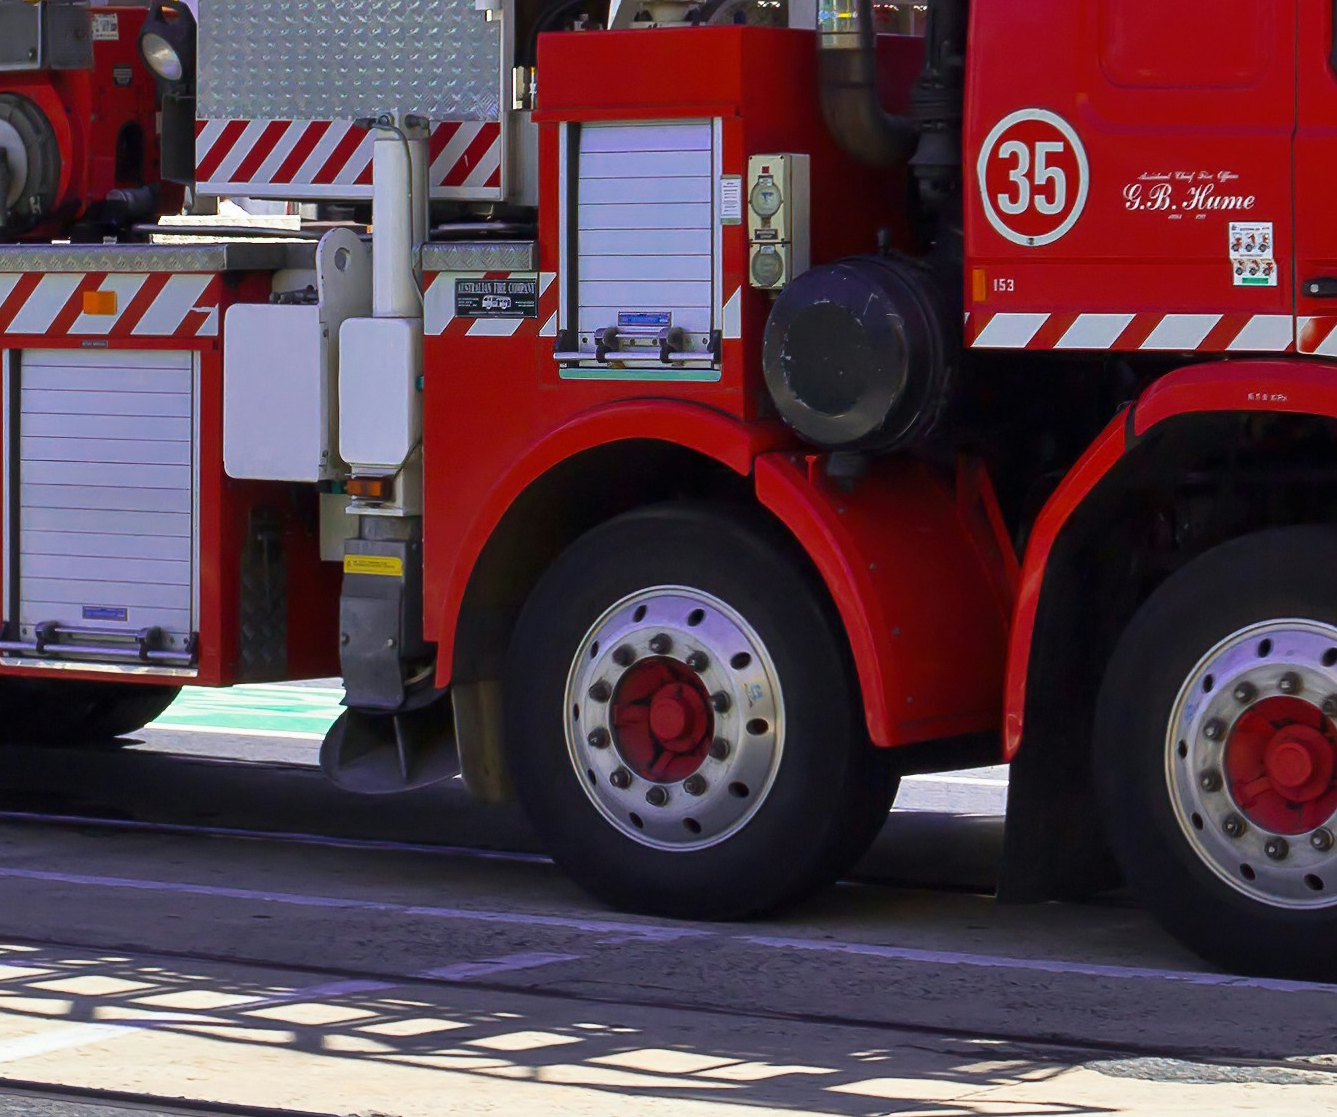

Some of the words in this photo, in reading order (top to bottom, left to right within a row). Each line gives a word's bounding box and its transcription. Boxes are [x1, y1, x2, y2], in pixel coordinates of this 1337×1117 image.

[998, 140, 1066, 215] 35
[1123, 183, 1177, 211] G.B.
[1182, 183, 1256, 211] Hume
[993, 279, 1015, 292] 153
